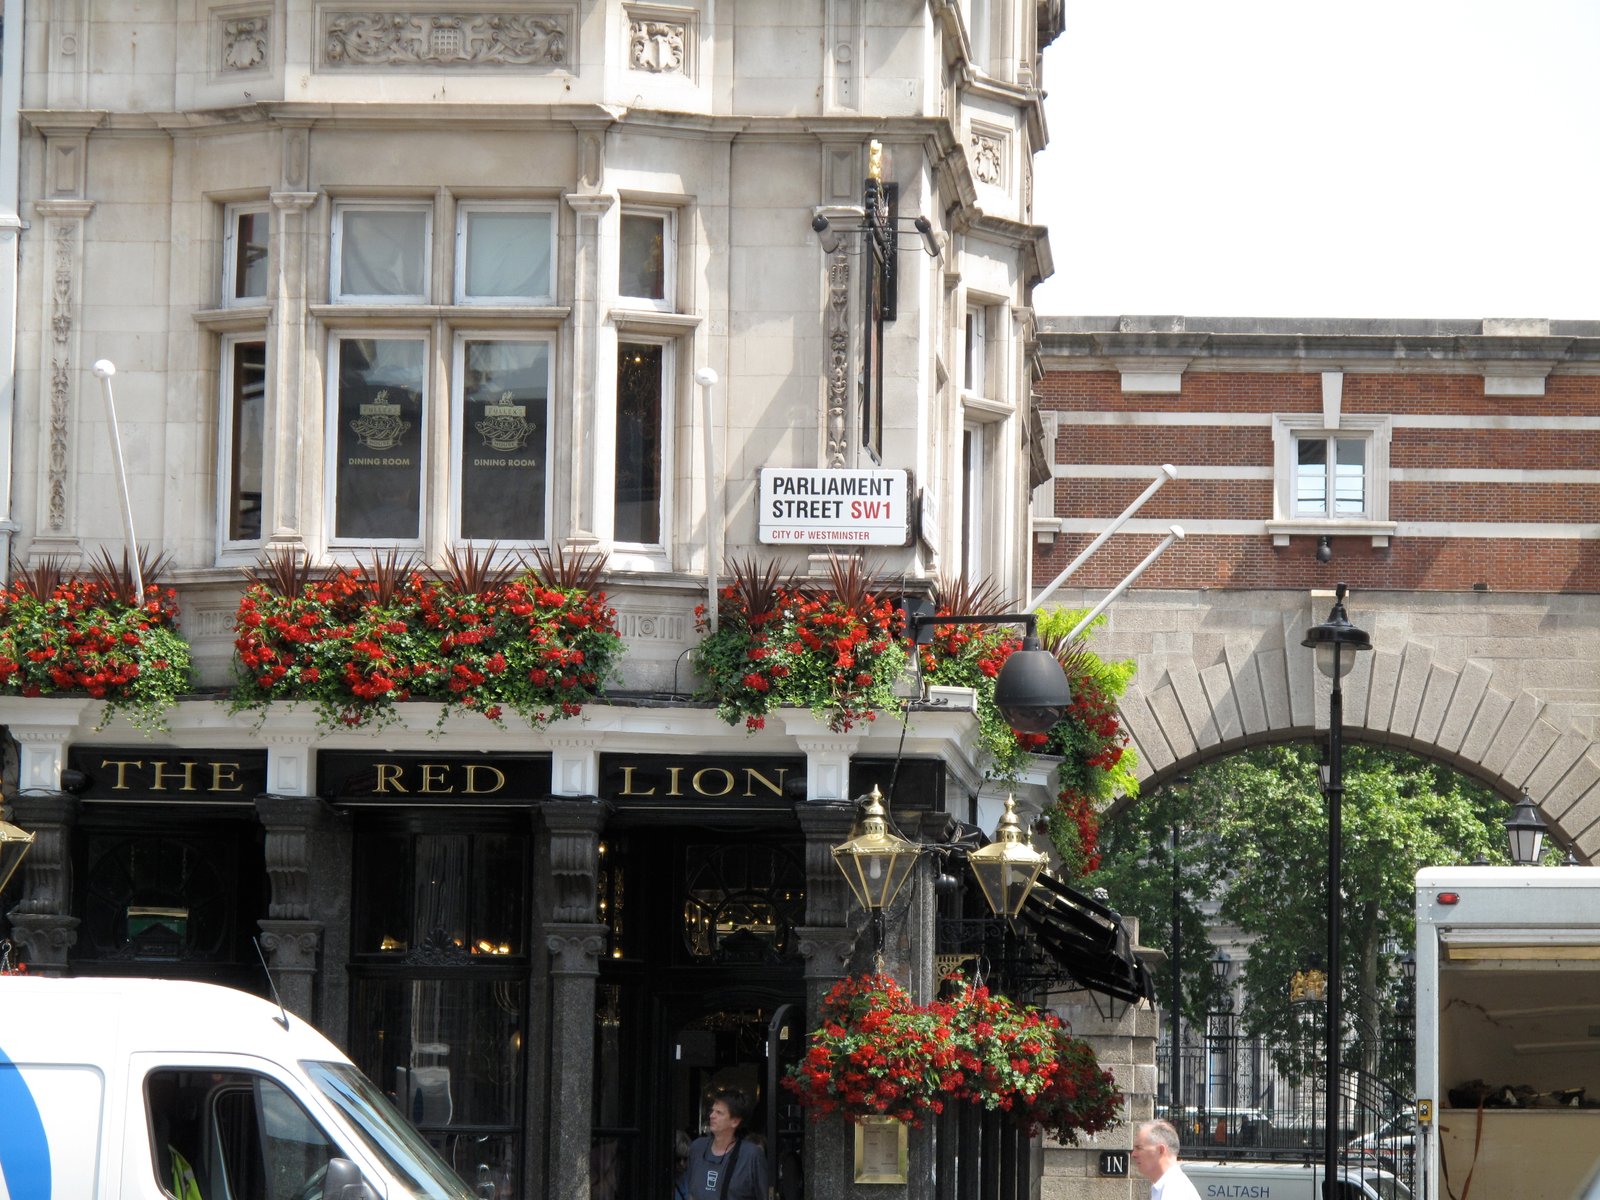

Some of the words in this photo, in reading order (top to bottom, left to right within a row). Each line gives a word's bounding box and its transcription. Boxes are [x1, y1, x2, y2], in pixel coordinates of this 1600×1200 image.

[508, 459, 536, 467] ROOM
[773, 477, 894, 496] PARLIAMENT
[772, 500, 843, 519] STREET
[851, 501, 891, 519] SW1
[772, 530, 791, 539] CITY
[794, 531, 805, 539] OF
[808, 531, 870, 540] WESTMINSTER
[101, 759, 245, 792] THE
[371, 763, 506, 794] RED
[618, 766, 789, 797] LION
[1106, 1156, 1123, 1173] IN
[1207, 1184, 1270, 1198] SALTASH
